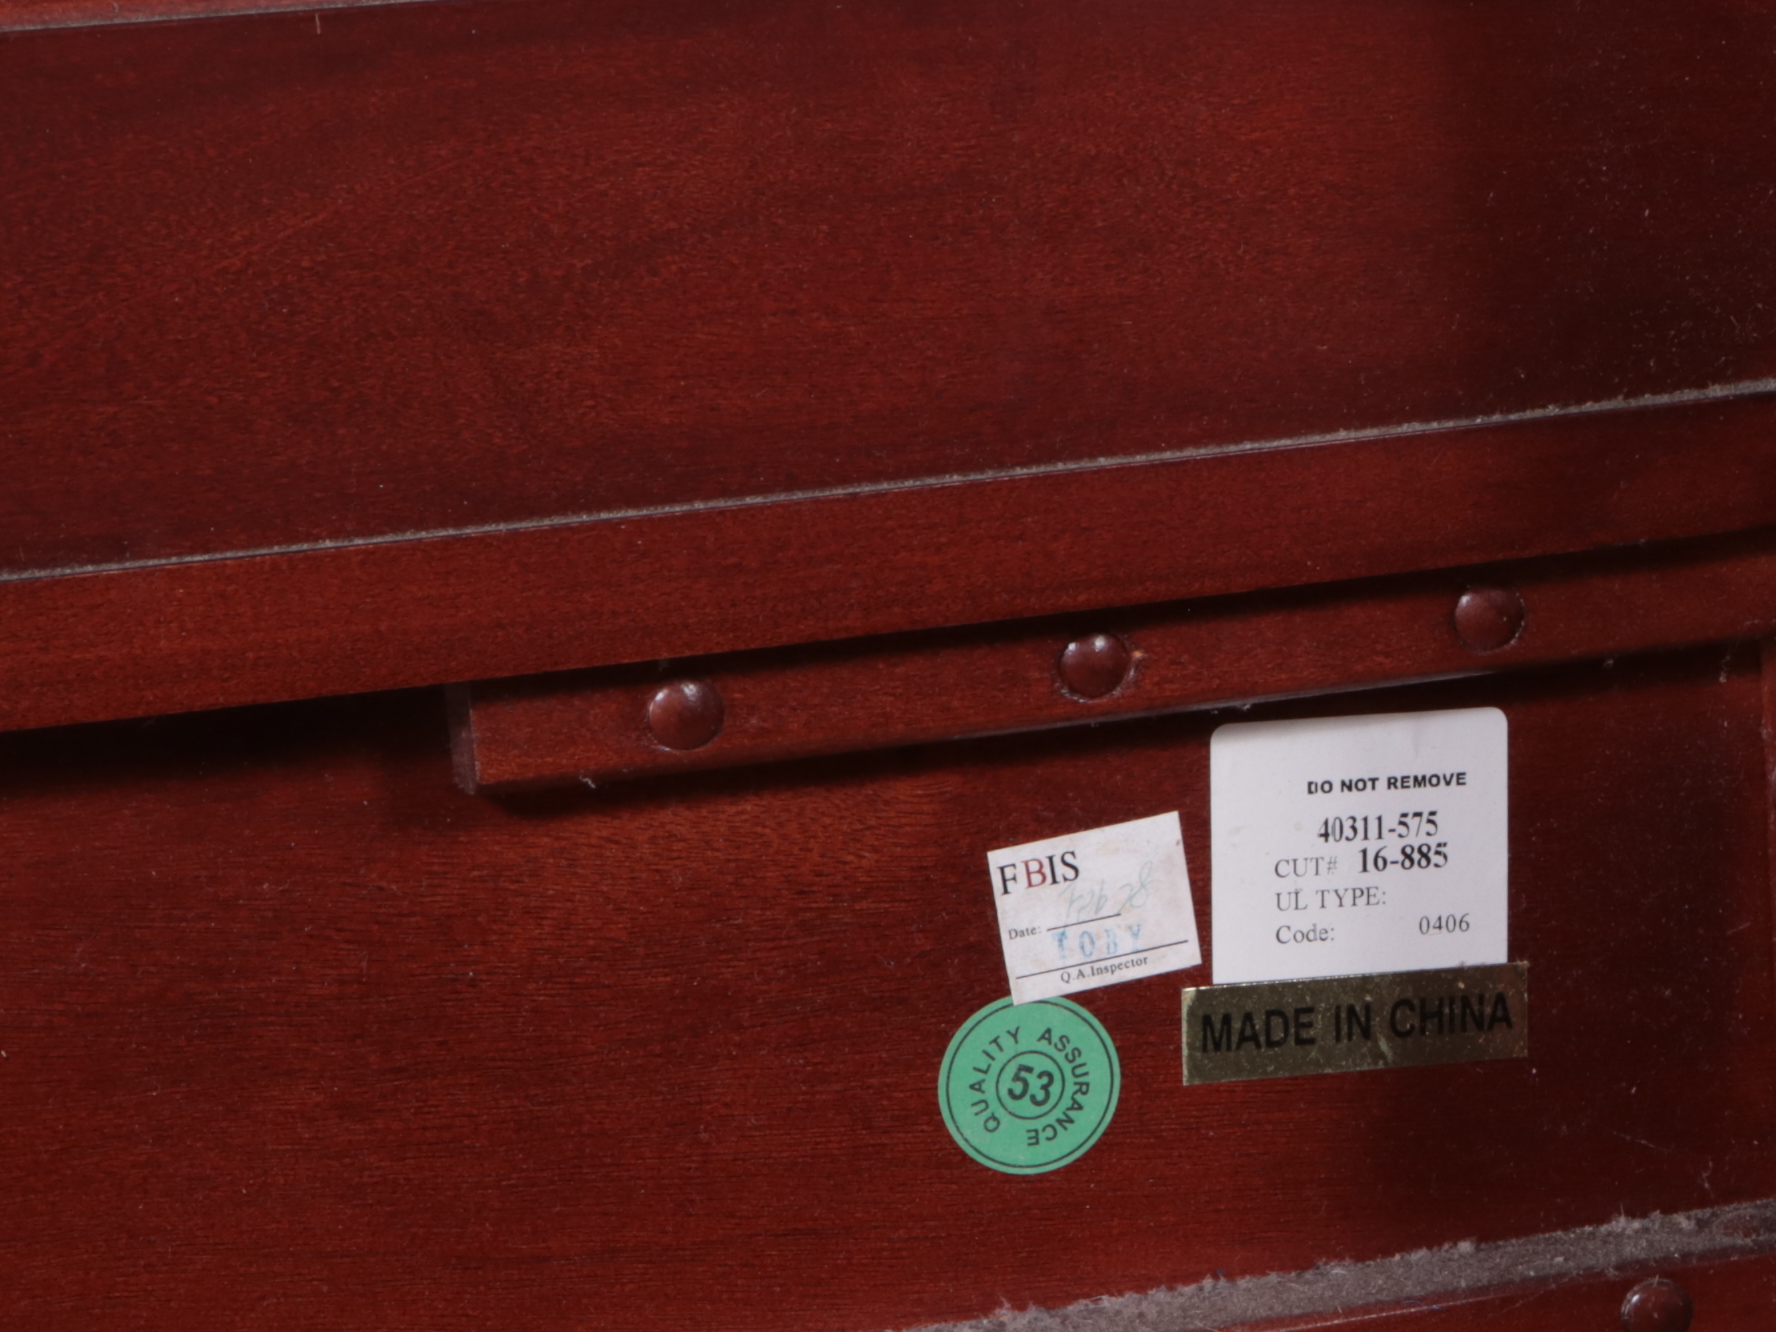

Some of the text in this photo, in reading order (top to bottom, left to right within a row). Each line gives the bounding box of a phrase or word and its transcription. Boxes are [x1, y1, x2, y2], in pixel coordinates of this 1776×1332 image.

[1307, 771, 1467, 795] DO NOT REMOVE
[1317, 810, 1439, 843] 40311-575
[996, 850, 1080, 896] FBIS
[1274, 842, 1449, 878] CUT# 16-885
[1275, 886, 1387, 912] UL TYPE:
[1008, 925, 1042, 940] Date:
[1275, 912, 1471, 944] Code: 0406
[1202, 991, 1513, 1055] MADE IN CHINA
[968, 1025, 1091, 1147] QUALITY ASSURANCE
[1007, 1063, 1055, 1107] 53
